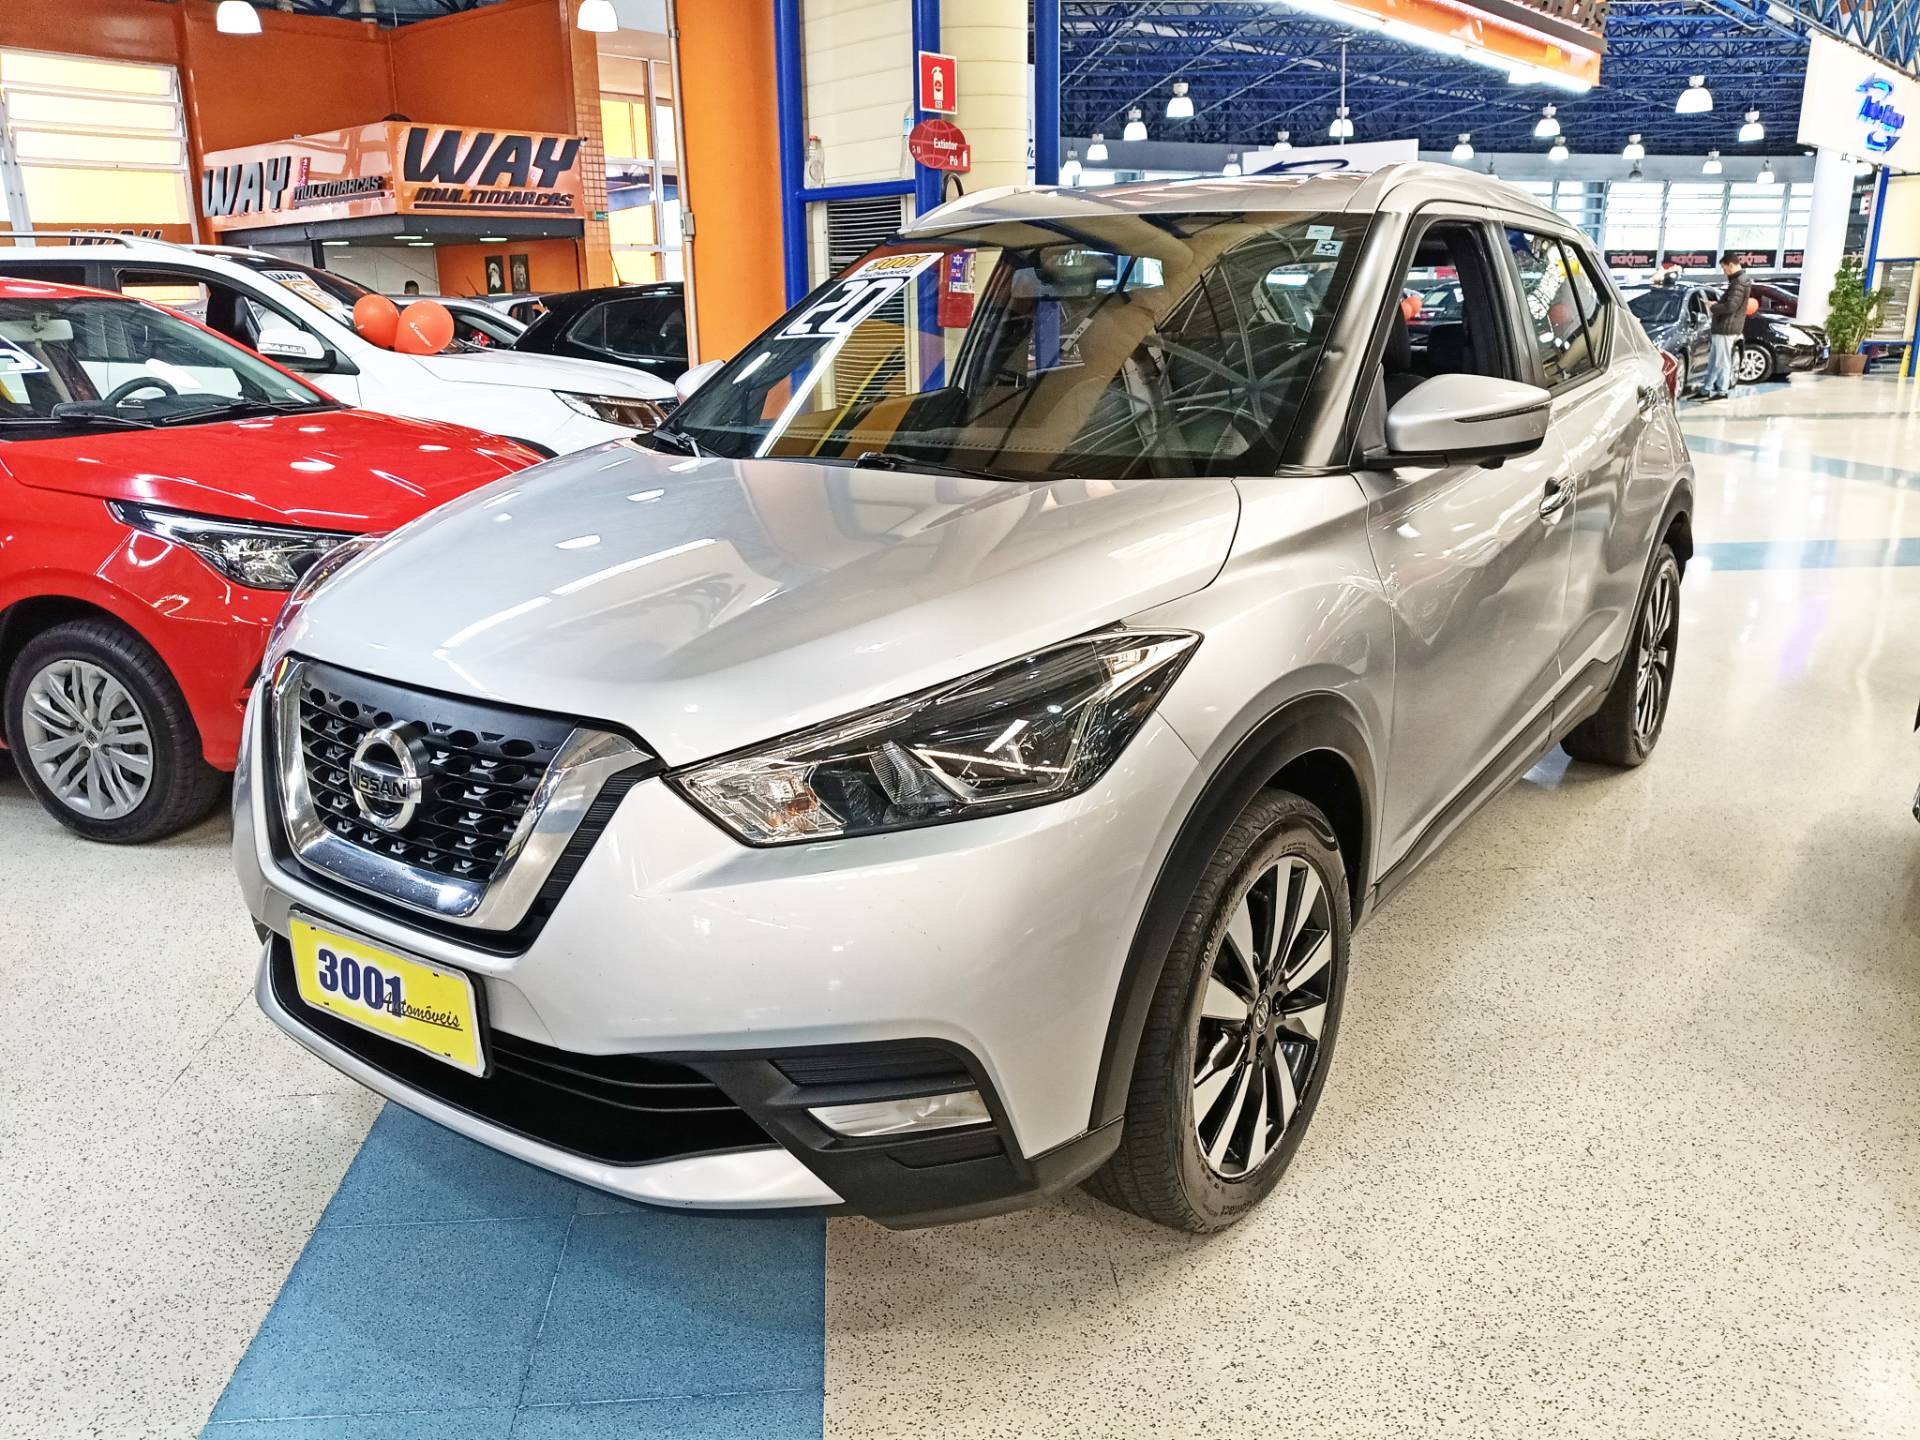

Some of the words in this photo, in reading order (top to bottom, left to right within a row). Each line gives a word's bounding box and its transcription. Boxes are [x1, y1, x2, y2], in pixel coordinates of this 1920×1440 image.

[202, 156, 291, 217] WAY
[404, 127, 582, 188] WAY
[415, 187, 574, 207] MULTIMARCAS
[782, 276, 907, 335] 20
[351, 763, 407, 798] NISSAN
[318, 949, 402, 1018] 3001
